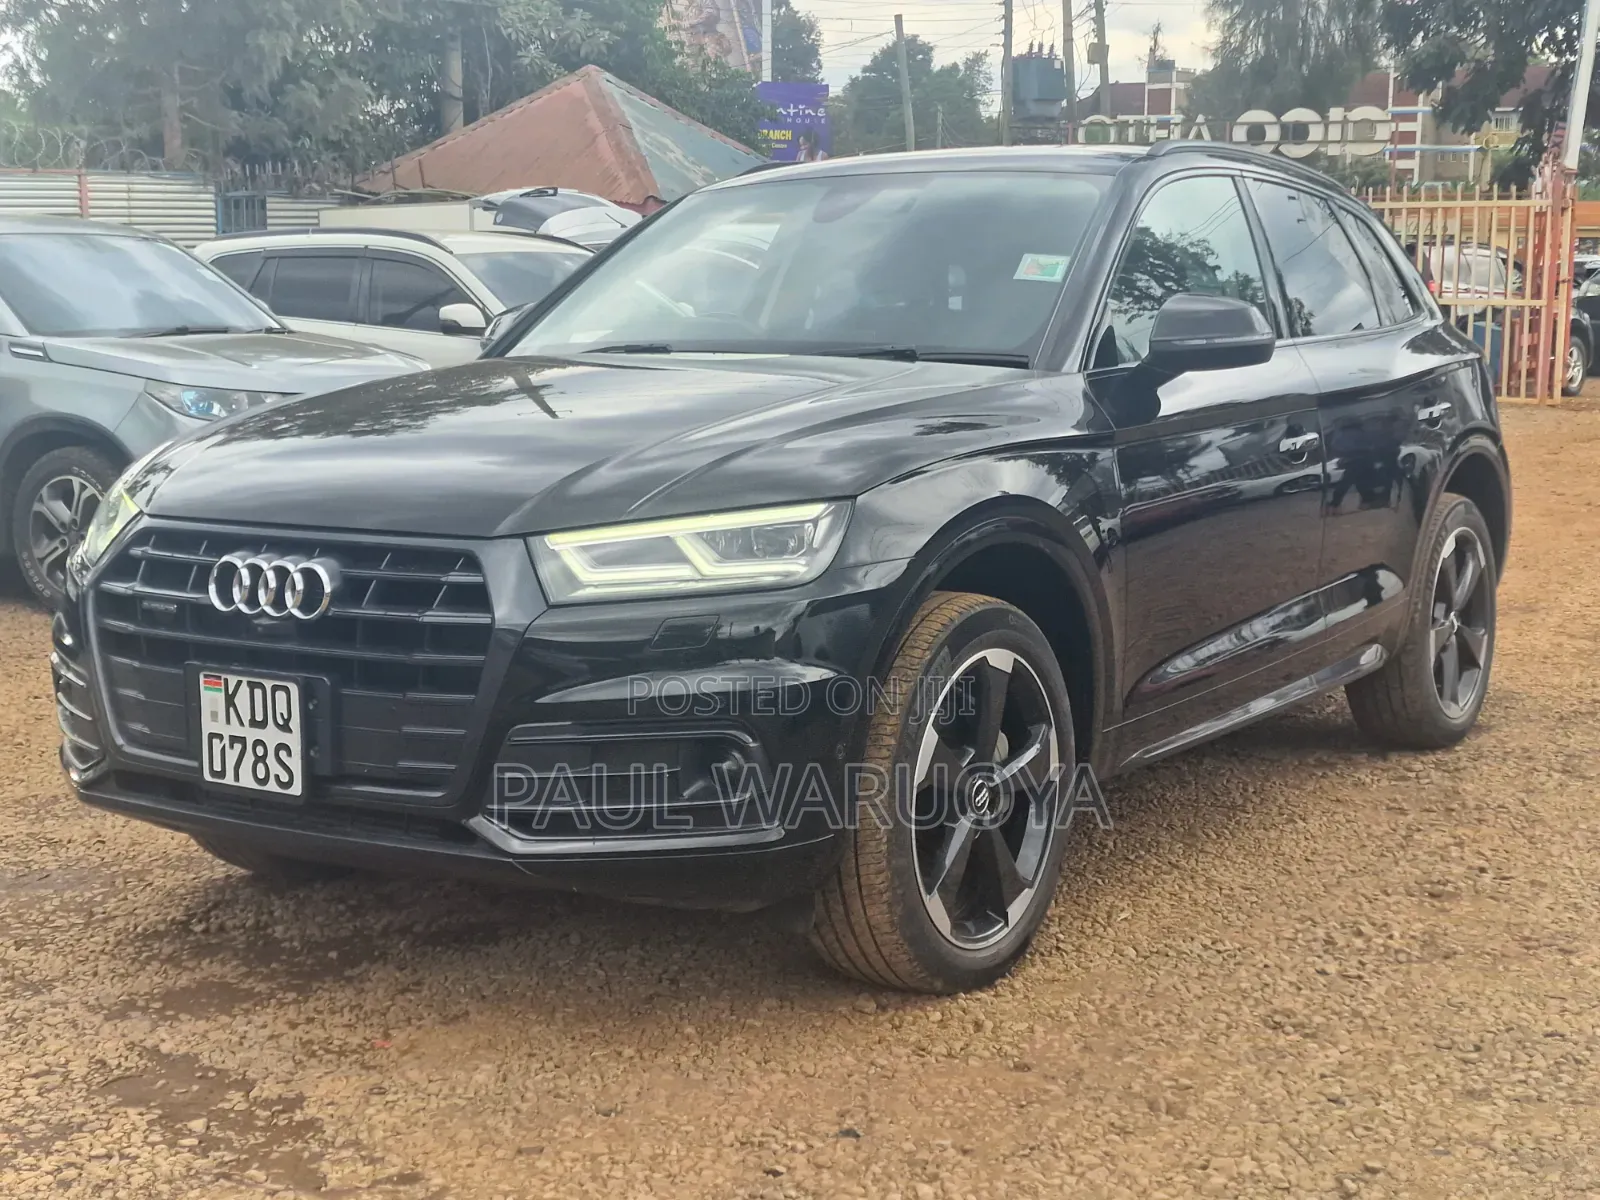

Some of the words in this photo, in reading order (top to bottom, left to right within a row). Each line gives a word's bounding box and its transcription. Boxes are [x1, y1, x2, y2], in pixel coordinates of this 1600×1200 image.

[776, 103, 826, 116] ntine
[223, 677, 293, 734] KDQ
[207, 731, 294, 791] 078S
